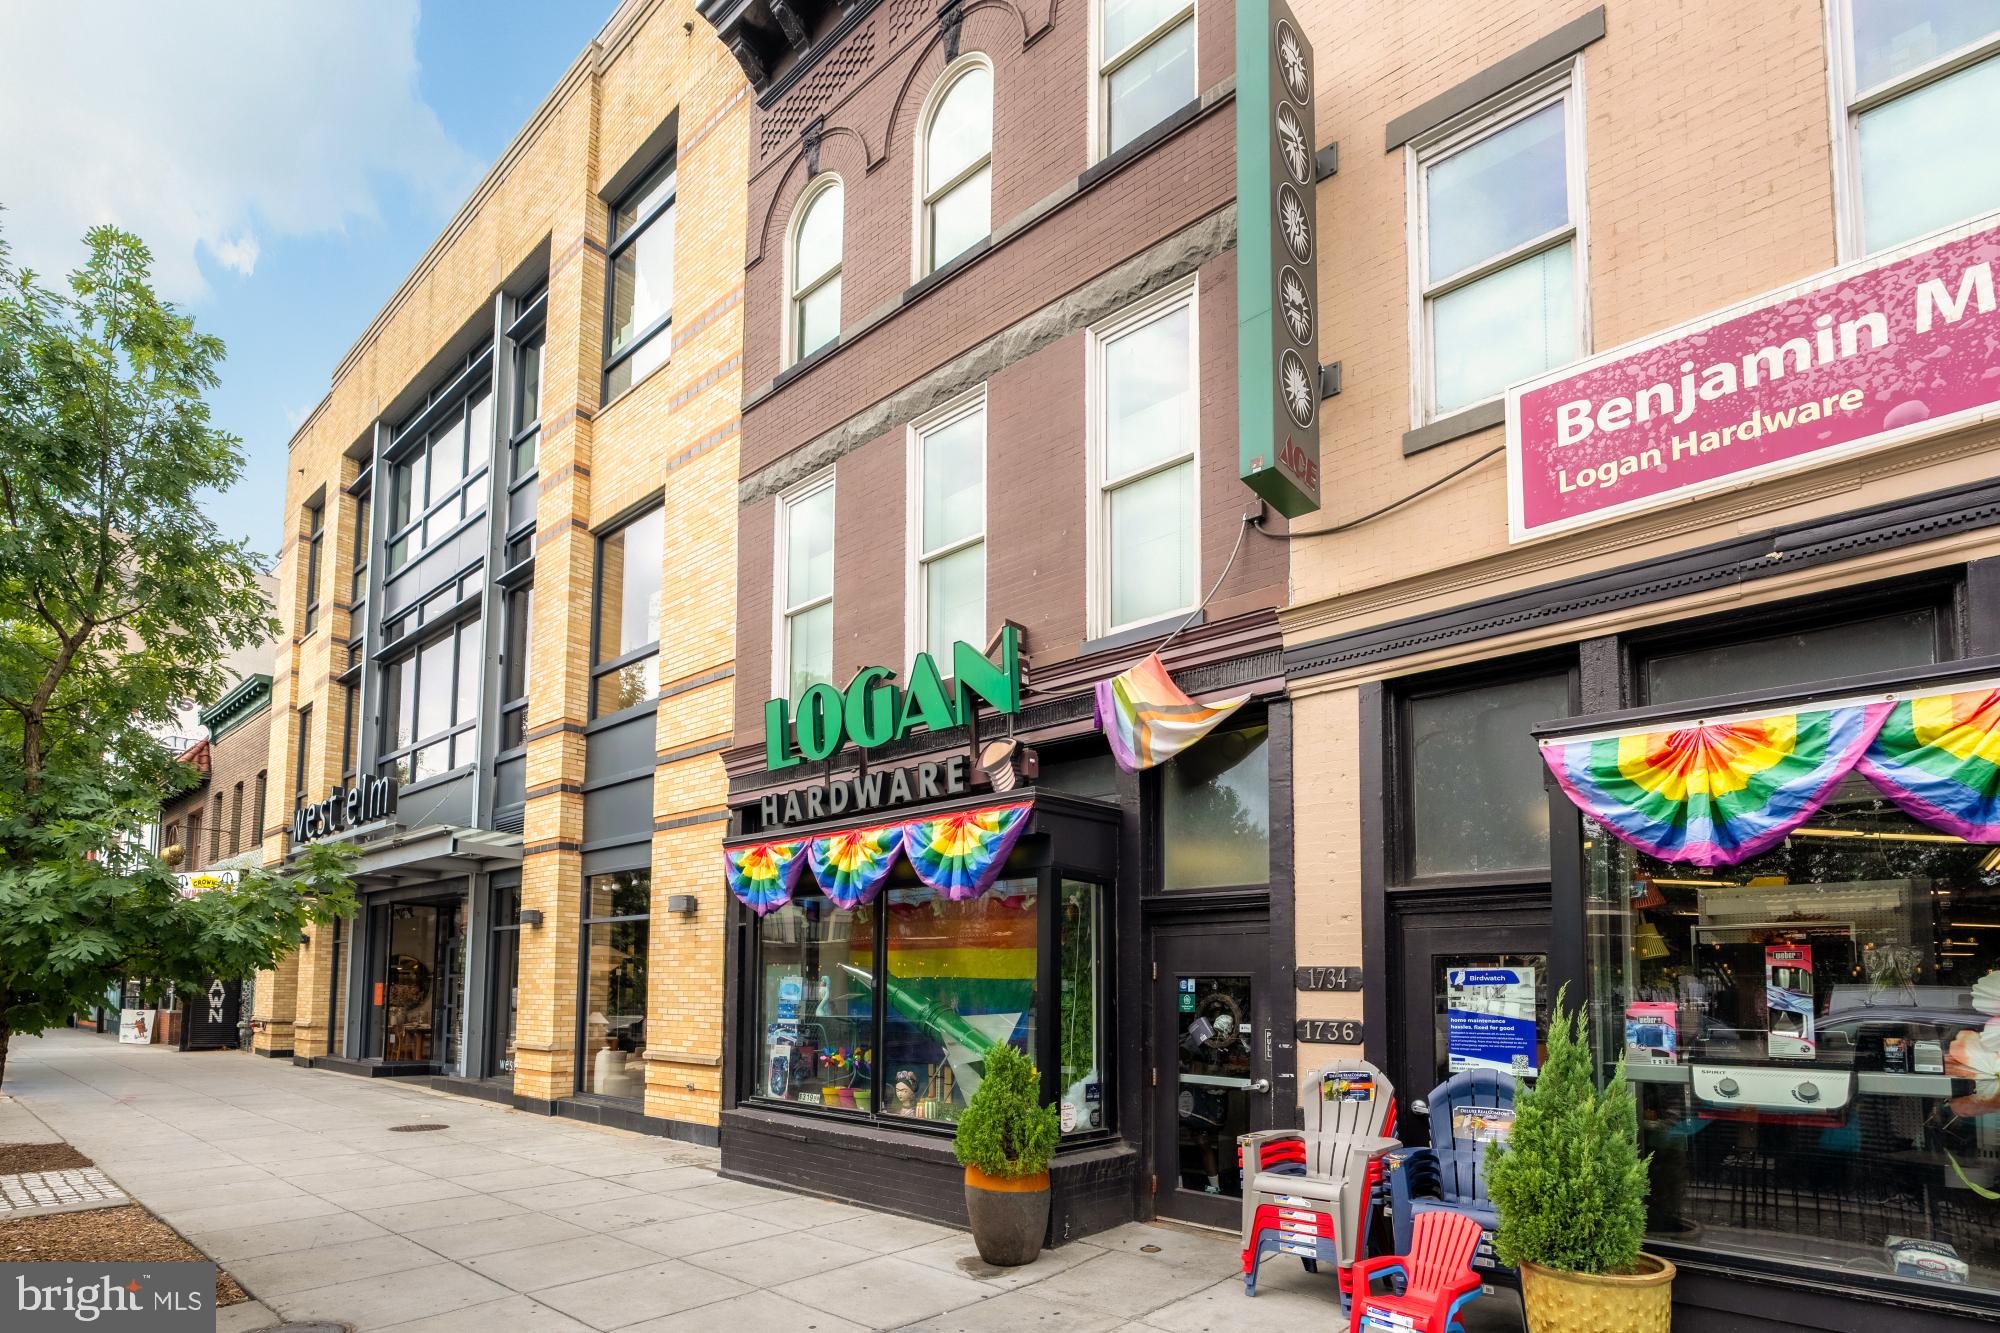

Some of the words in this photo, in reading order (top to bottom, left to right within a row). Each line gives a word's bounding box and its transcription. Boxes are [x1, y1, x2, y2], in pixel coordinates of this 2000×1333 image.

[1556, 313, 1889, 448] Benjamin
[1279, 433, 1317, 492] ACE
[1558, 448, 1662, 494] Logan
[1670, 387, 1865, 462] Hardware
[764, 624, 1020, 772] LOGAN
[292, 786, 342, 843] west
[346, 773, 394, 826] elm
[760, 755, 971, 828] HARDWARE
[1308, 968, 1347, 989] 1734
[1775, 952, 1796, 960] weber
[208, 979, 226, 1024] AWN
[1304, 1021, 1354, 1041] 1736
